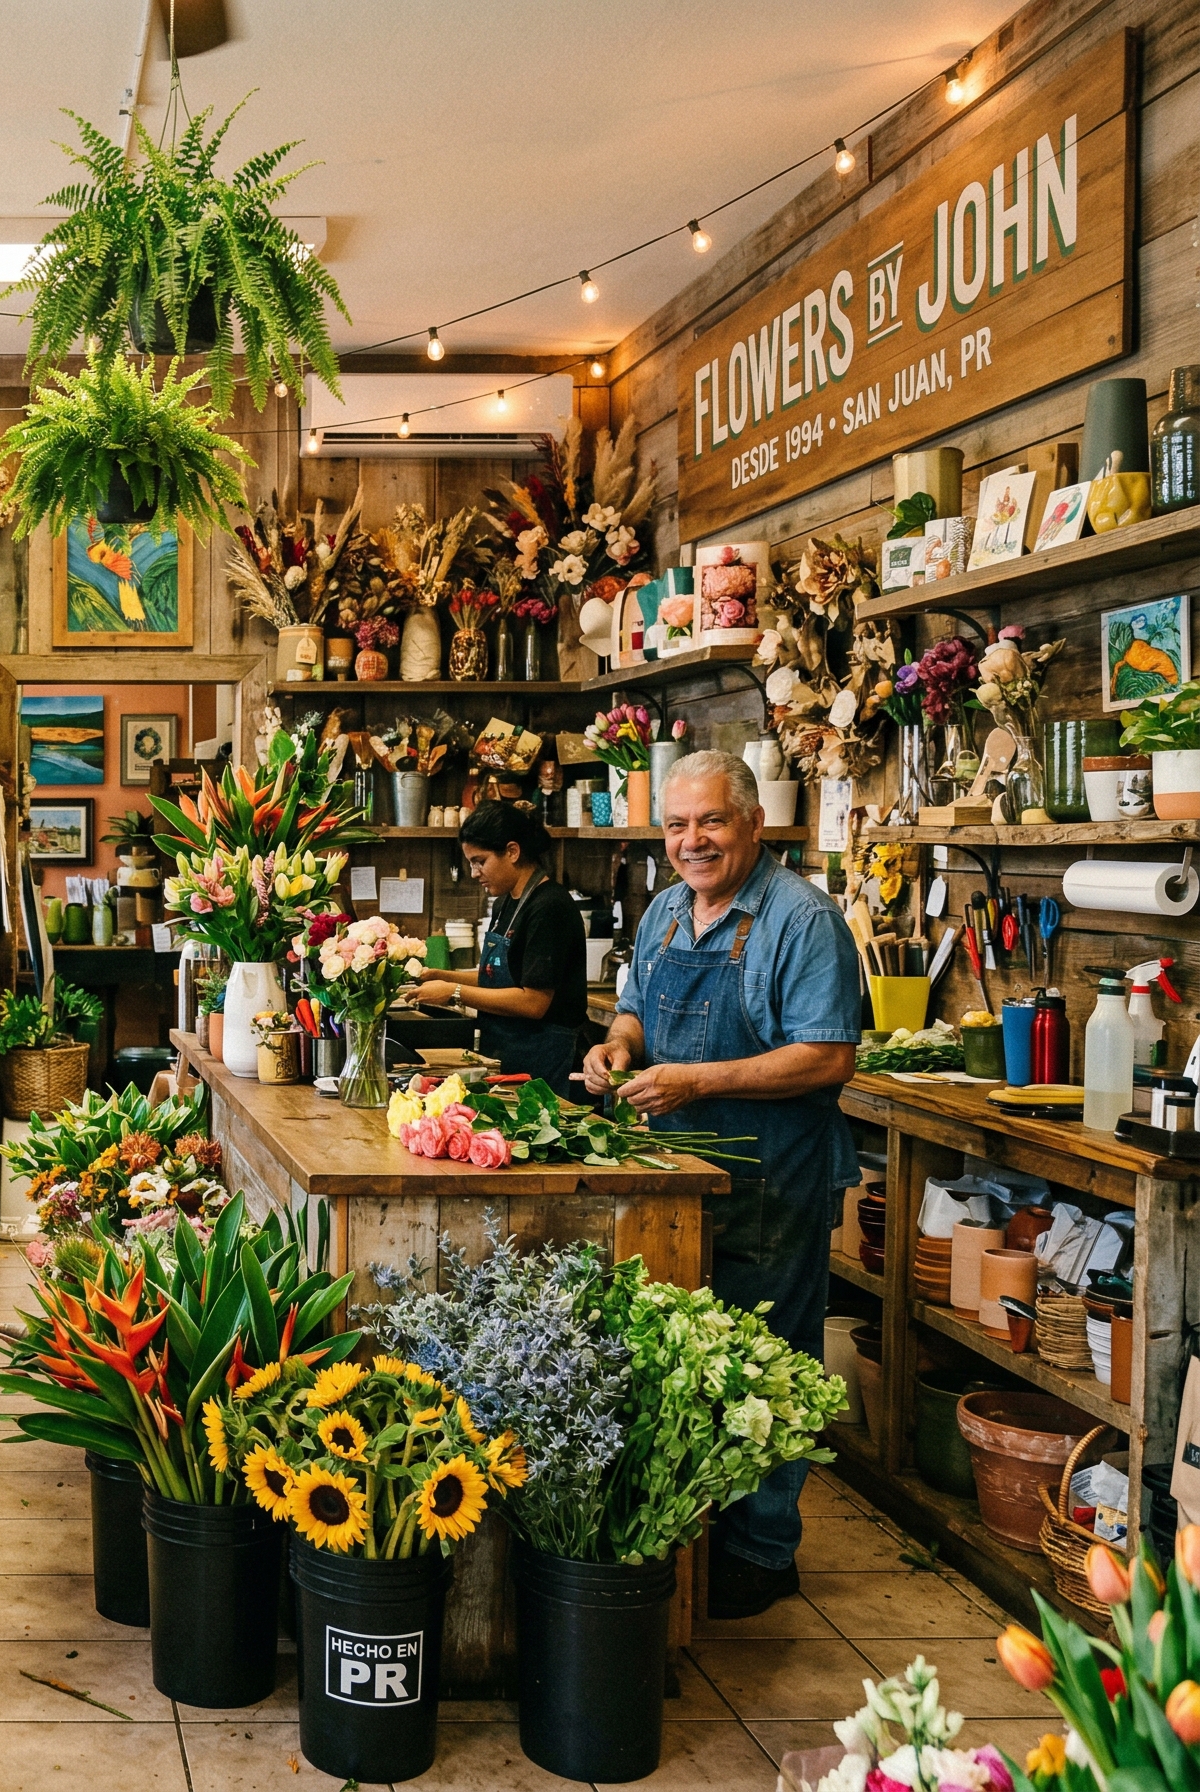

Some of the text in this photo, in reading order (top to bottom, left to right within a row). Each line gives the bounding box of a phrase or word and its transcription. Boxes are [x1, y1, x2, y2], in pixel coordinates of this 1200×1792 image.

[694, 112, 1078, 458] FLOWERS BY JOHN
[731, 326, 992, 490] DESDE 1994 SAN JUAN, PR
[331, 1636, 418, 1659] HECHO EN
[340, 1657, 409, 1699] PR
